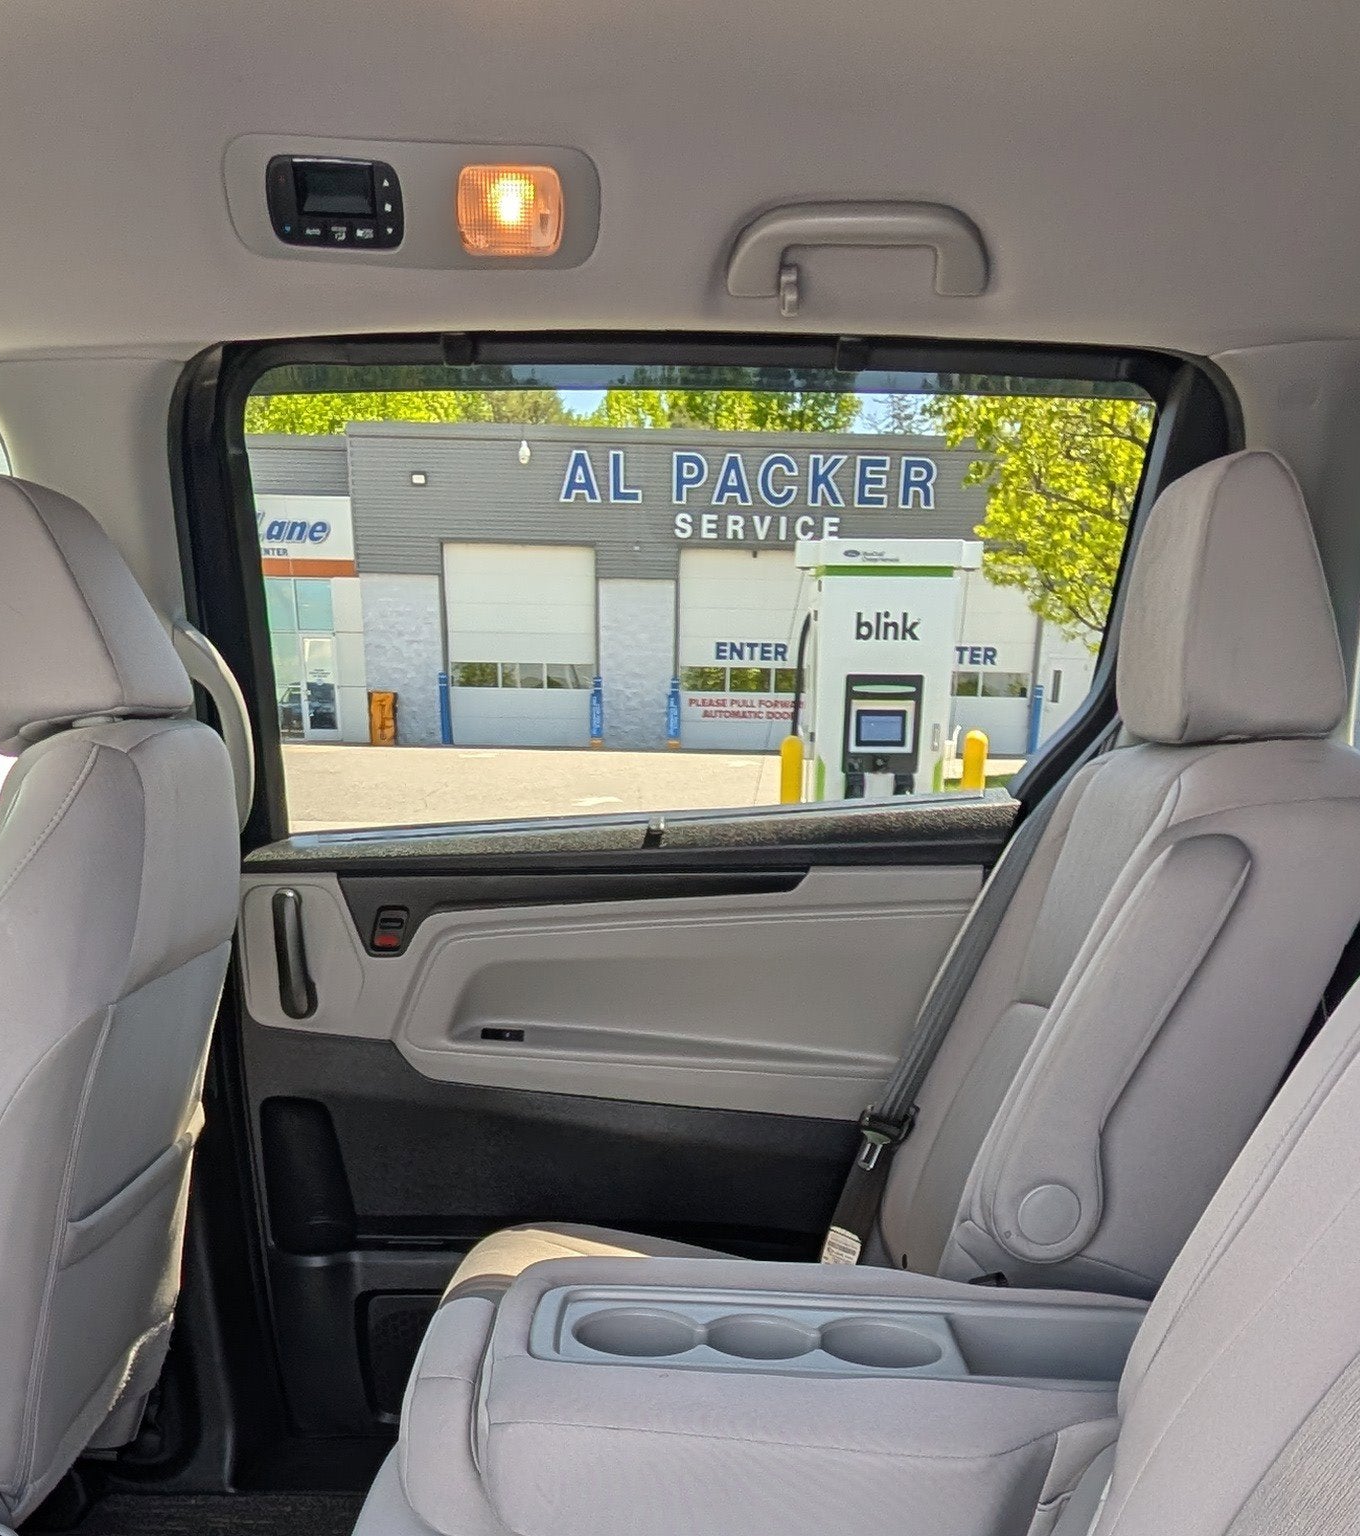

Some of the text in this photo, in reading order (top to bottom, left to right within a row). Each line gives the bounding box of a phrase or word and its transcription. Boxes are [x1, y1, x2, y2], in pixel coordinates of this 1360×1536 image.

[559, 450, 937, 509] AL PACKER
[257, 511, 330, 543] ane
[674, 512, 840, 540] SERVICE
[261, 548, 288, 556] NTER
[855, 611, 920, 641] blink
[715, 641, 788, 662] ENTER
[955, 646, 997, 665] TER
[688, 698, 727, 707] PLEASE
[731, 699, 756, 708] PULL
[703, 709, 763, 719] AUTOMATIC
